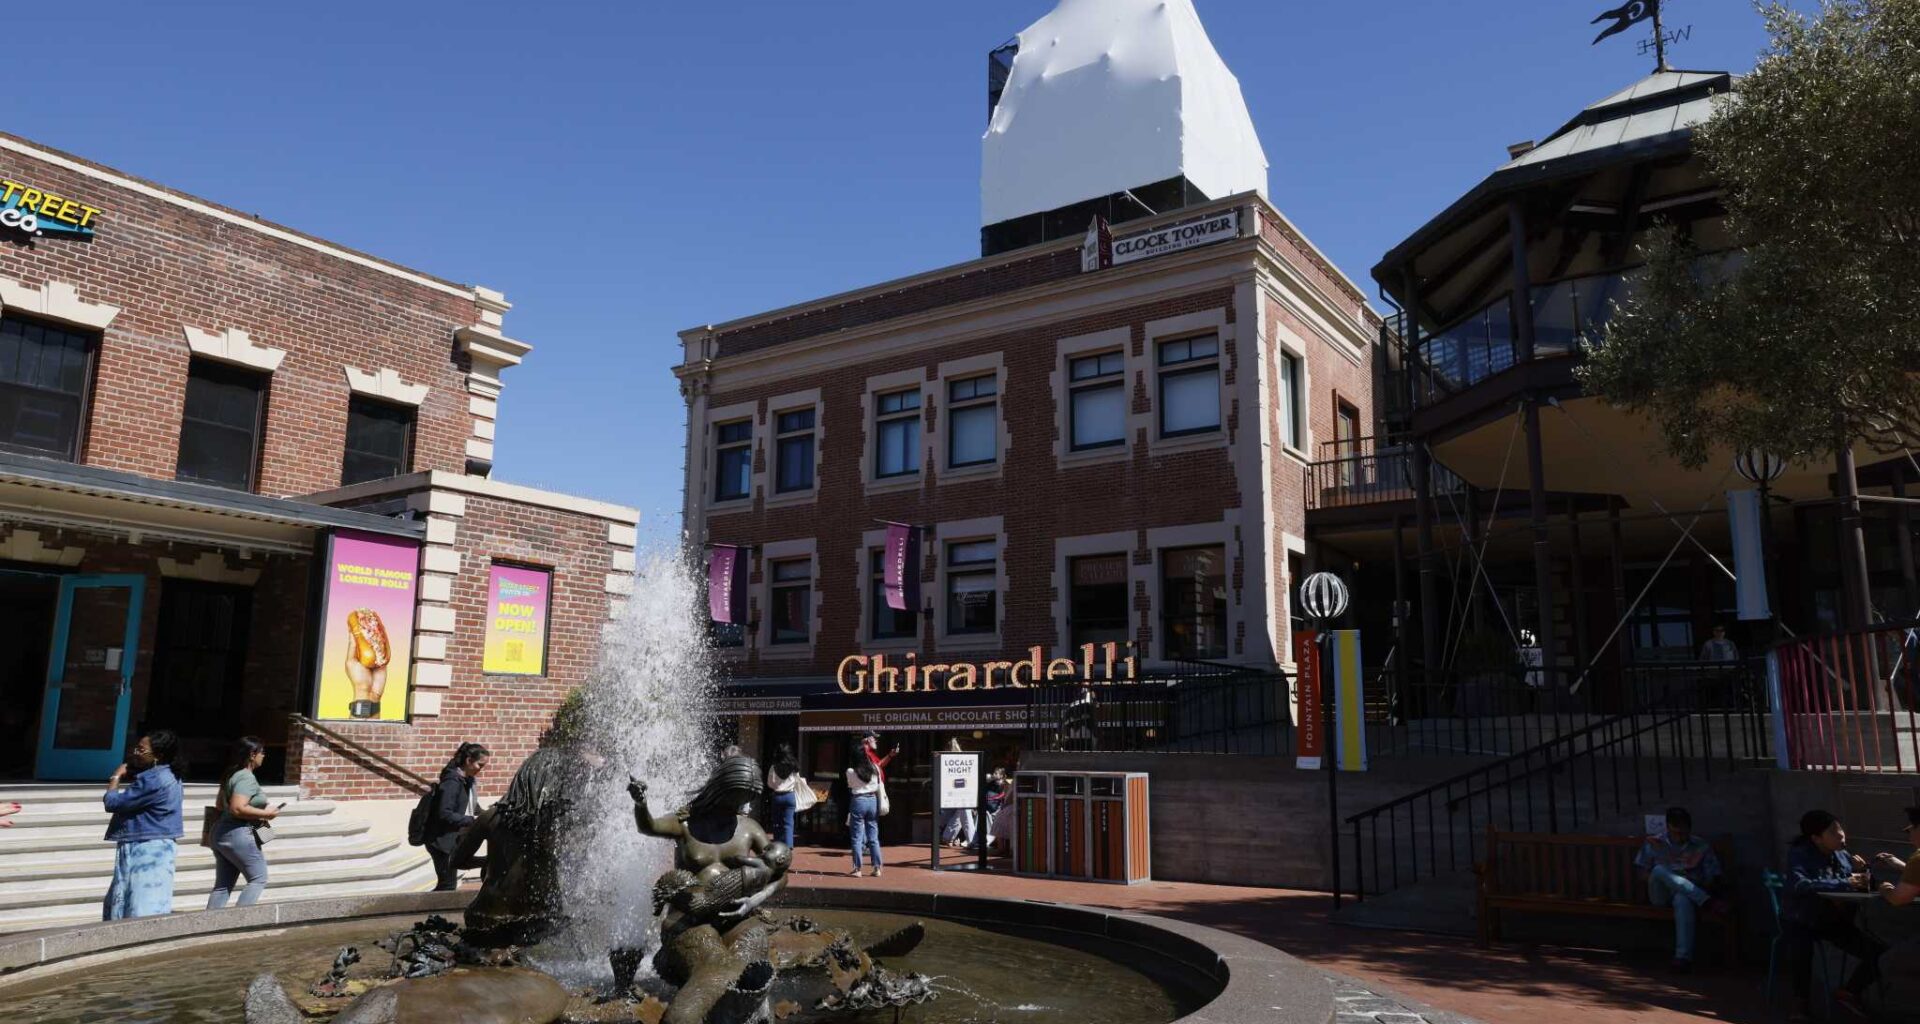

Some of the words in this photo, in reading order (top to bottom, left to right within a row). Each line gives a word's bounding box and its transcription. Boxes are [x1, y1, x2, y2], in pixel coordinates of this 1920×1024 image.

[0, 180, 102, 227] TREET
[1115, 232, 1169, 255] CLOCK
[1171, 217, 1232, 240] TOWER
[1145, 242, 1183, 255] BUILDING
[337, 563, 373, 576] WORLD
[374, 568, 412, 580] FAMOUS
[897, 537, 905, 599] GHIRARDELLI
[340, 573, 379, 586] LOBSTER
[380, 579, 409, 590] ROLLS
[722, 557, 731, 612] GHIRARDELLI
[498, 602, 535, 618] NOW
[495, 617, 537, 634] OPEN!
[1303, 639, 1311, 678] PLAZA
[837, 640, 1137, 695] Ghirardelli
[733, 701, 748, 709] THE
[750, 701, 775, 709] WORLD
[863, 713, 882, 722] THE
[885, 712, 933, 722] ORIGINAL
[937, 711, 1001, 721] CHOCOLATE
[1304, 684, 1313, 749] FOUNTAIN
[948, 766, 972, 774] NIGHT
